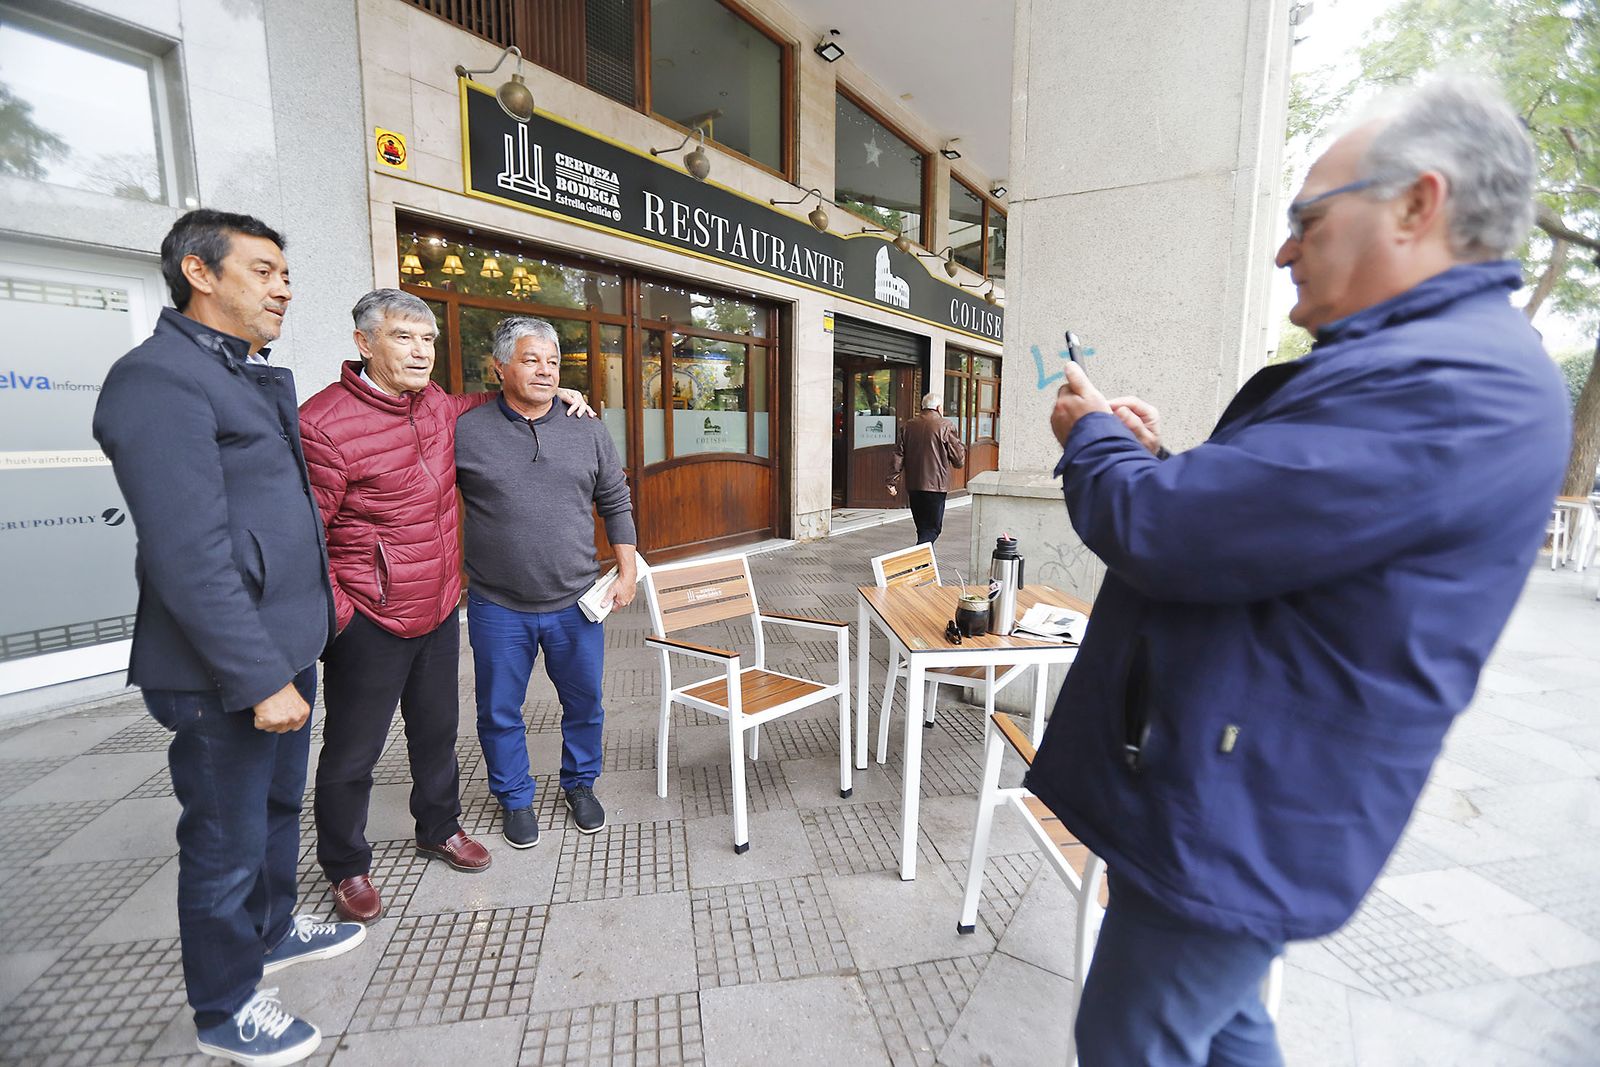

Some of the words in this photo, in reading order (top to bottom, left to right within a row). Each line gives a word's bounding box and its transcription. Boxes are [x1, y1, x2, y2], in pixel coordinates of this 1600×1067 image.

[555, 152, 620, 185] CERVEZA
[582, 174, 597, 187] DE
[555, 175, 620, 208] BODEGA
[555, 193, 586, 211] Estrella
[585, 202, 612, 218] Galicia
[642, 190, 845, 289] RESTAURANTE
